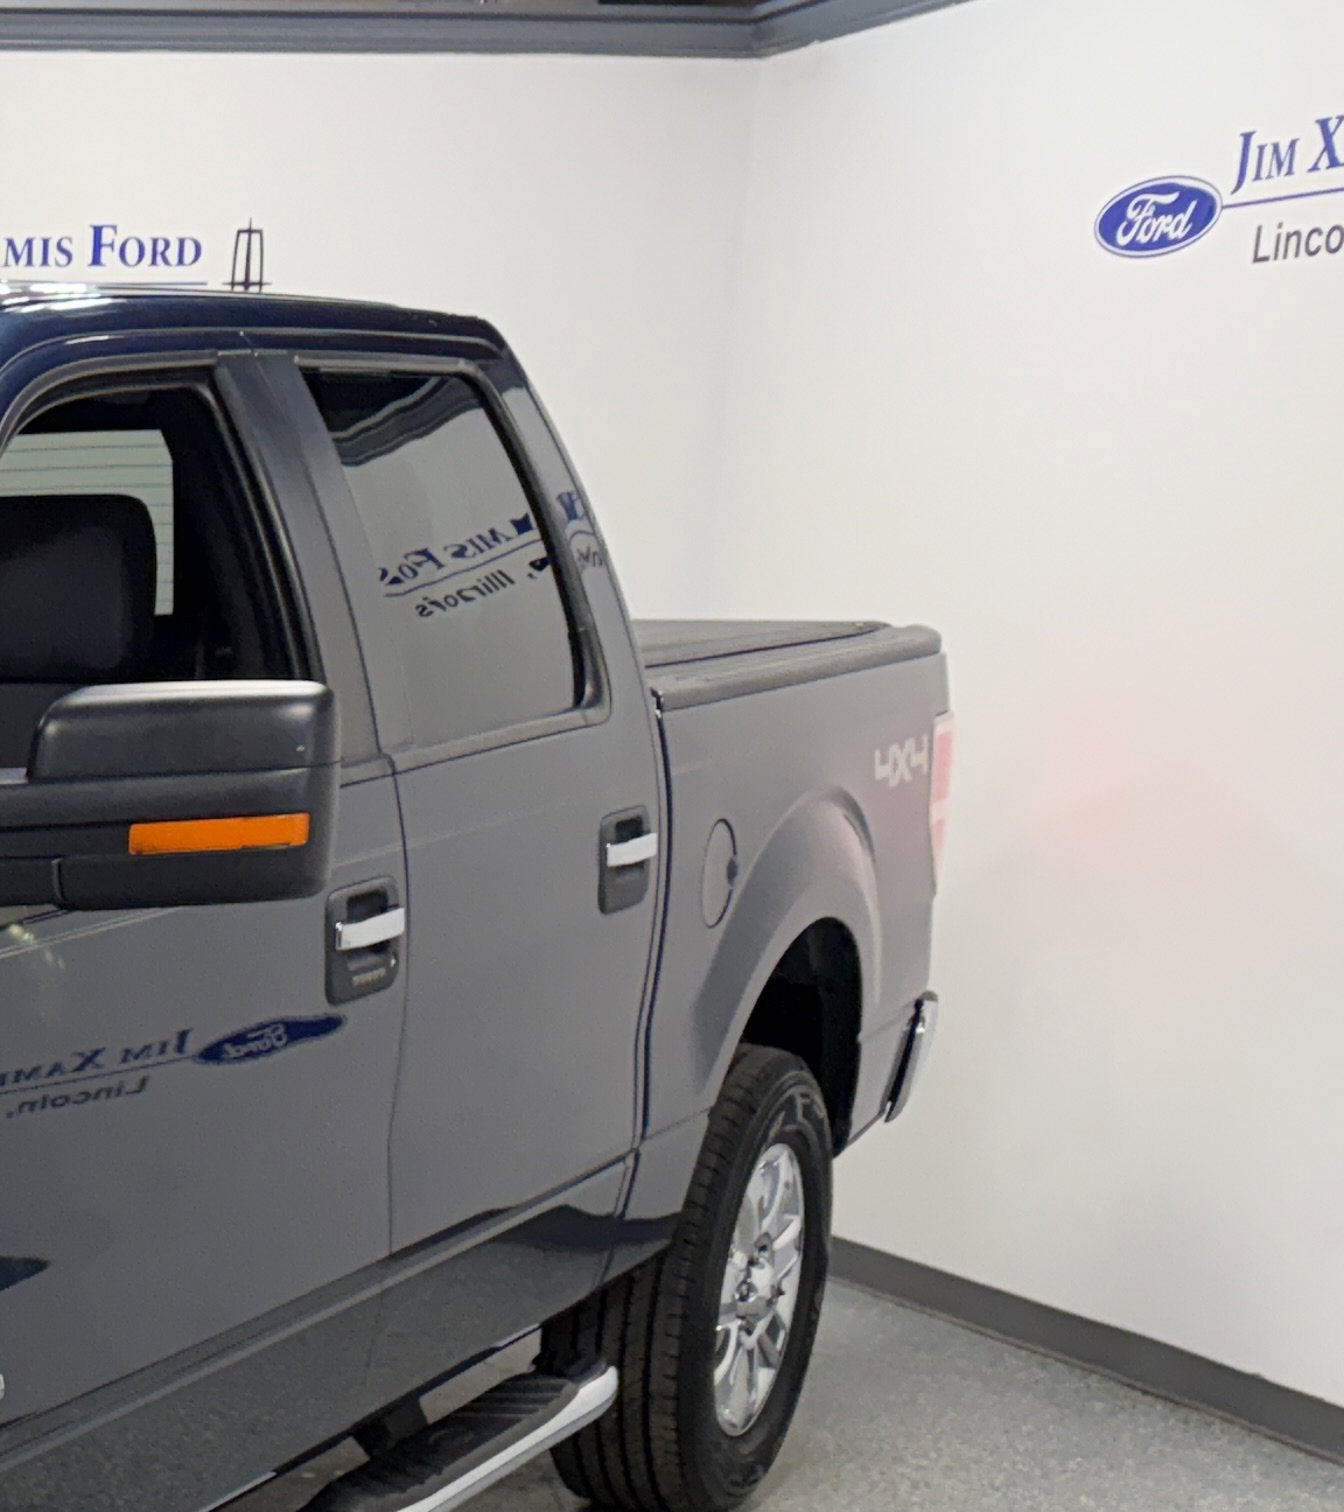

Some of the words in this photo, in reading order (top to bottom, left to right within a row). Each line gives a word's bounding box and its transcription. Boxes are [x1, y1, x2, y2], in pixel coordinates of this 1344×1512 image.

[1231, 130, 1300, 195] JIM
[89, 225, 202, 267] FORD
[1116, 192, 1197, 246] Ford
